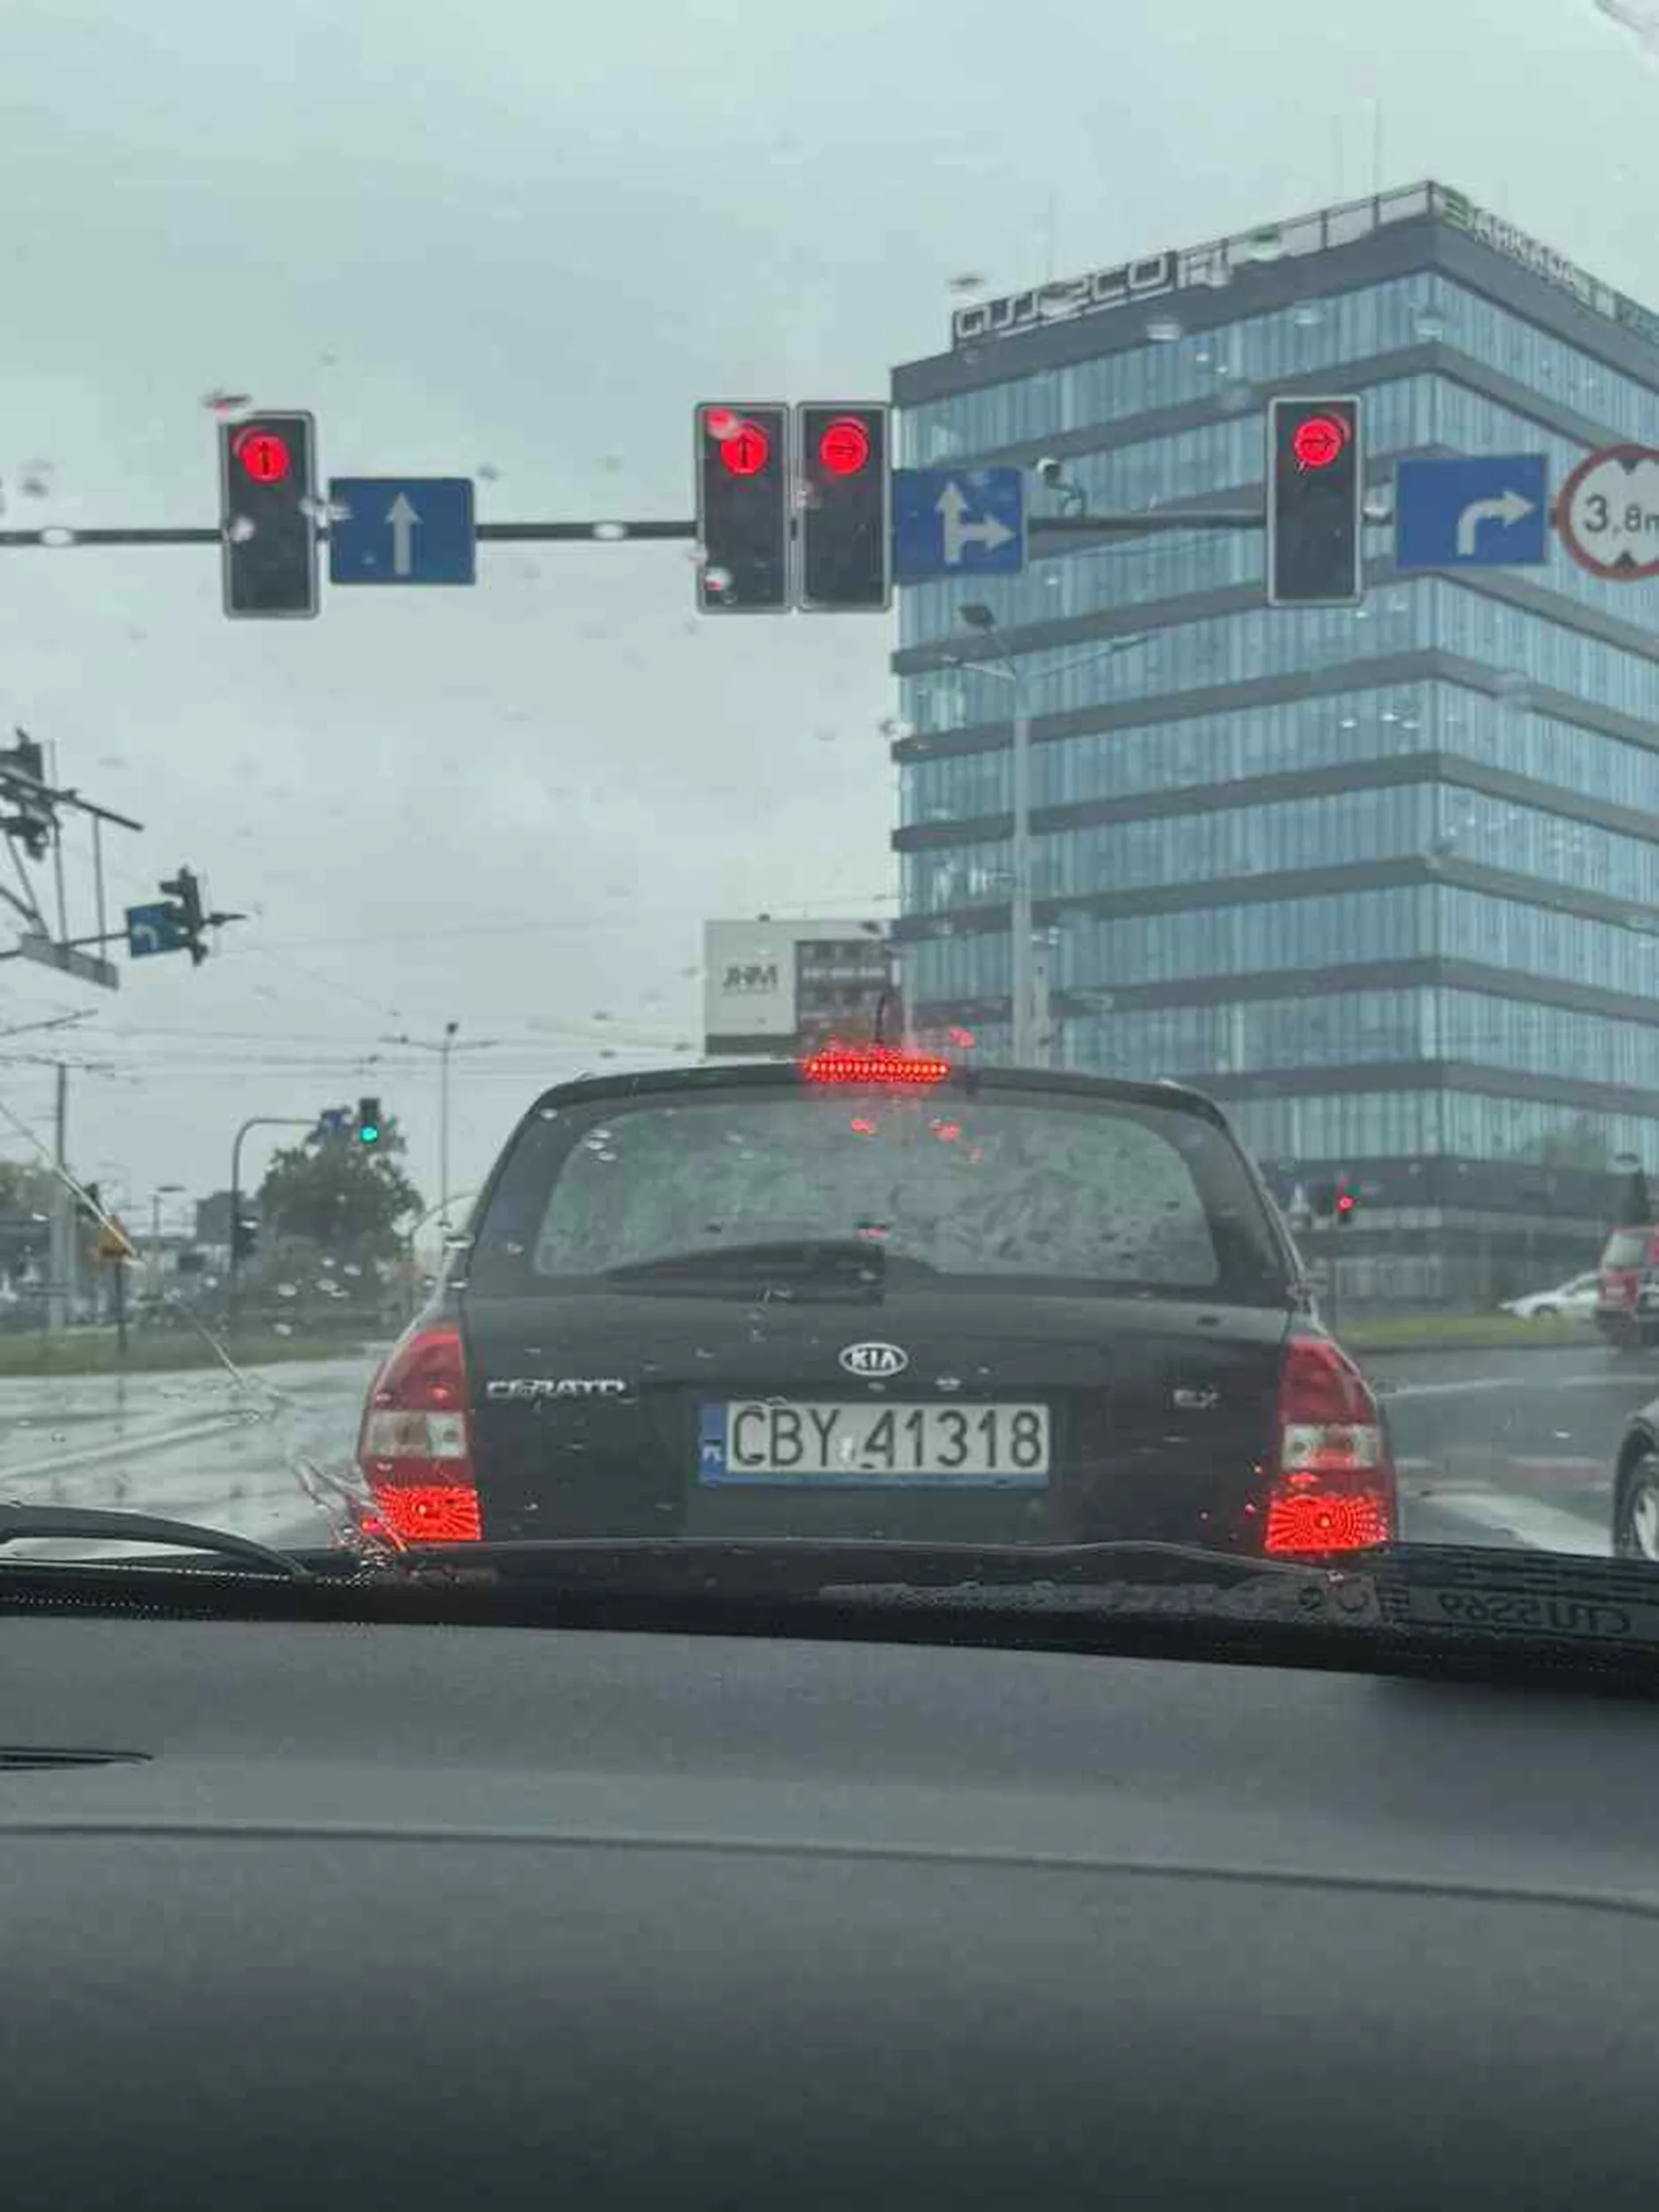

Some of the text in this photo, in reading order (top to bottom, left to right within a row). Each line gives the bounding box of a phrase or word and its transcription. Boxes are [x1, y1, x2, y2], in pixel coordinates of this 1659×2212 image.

[851, 1350, 896, 1370] KIA
[733, 1409, 1043, 1469] CBY 41318
